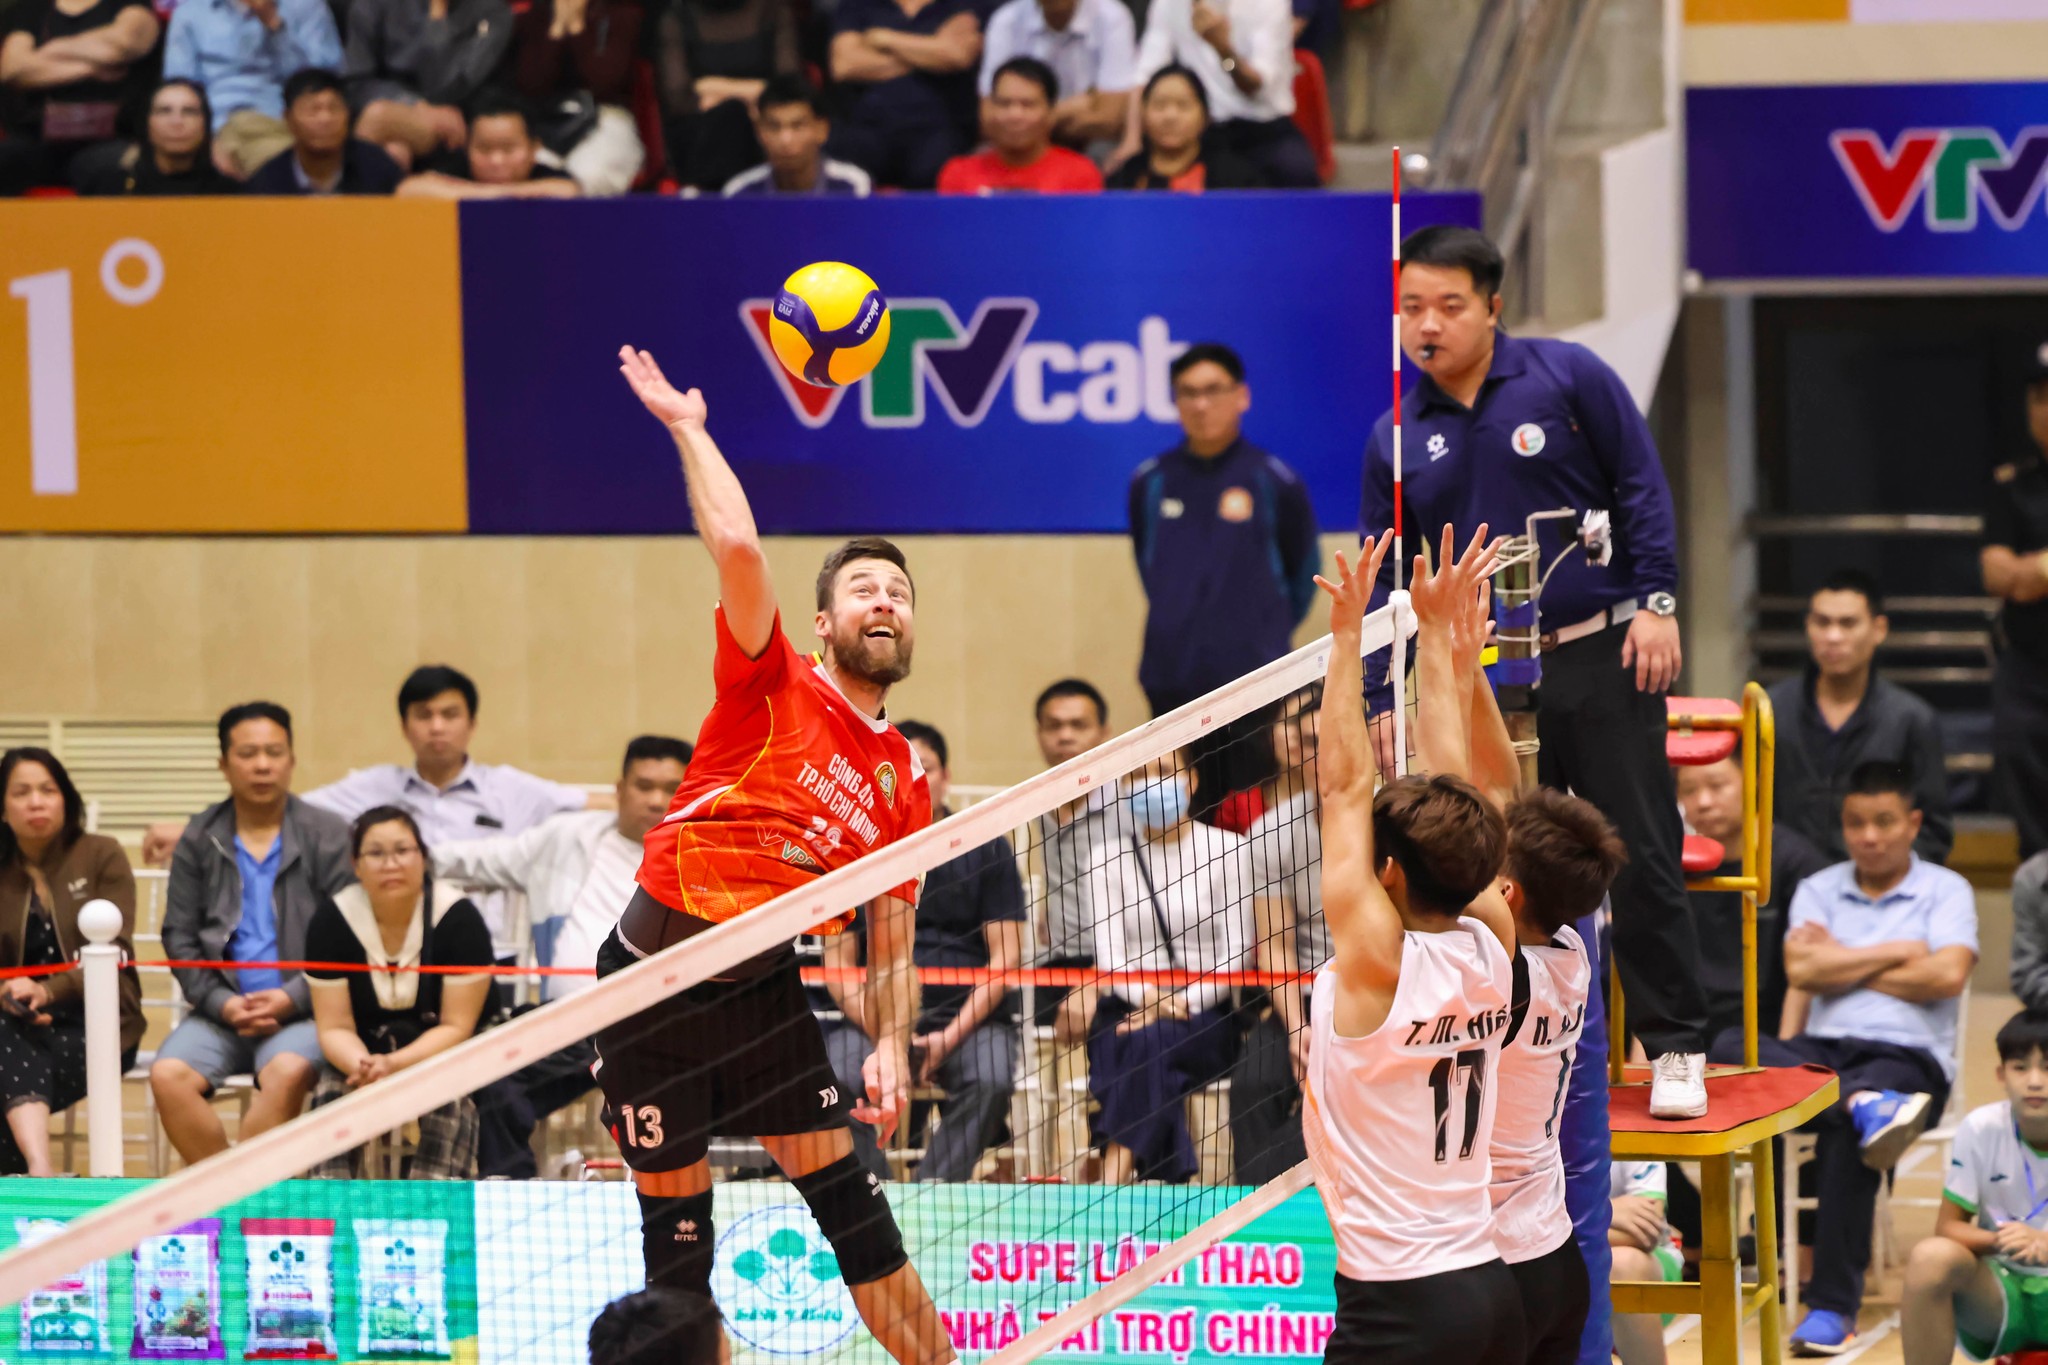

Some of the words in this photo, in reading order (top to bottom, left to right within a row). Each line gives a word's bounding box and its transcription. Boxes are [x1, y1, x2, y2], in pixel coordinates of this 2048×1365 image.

[828, 753, 863, 794] CÔNG
[847, 807, 880, 847] MINH
[1404, 1020, 1427, 1046] T.
[1429, 1014, 1460, 1044] M.
[621, 1105, 664, 1148] 13
[1428, 1048, 1488, 1164] 17
[971, 1242, 1077, 1282] SUPE
[1201, 1244, 1301, 1284] THAO
[940, 1303, 1021, 1350] NHÀ
[1115, 1311, 1194, 1361] TRỢ
[1208, 1306, 1334, 1354] CHÍNH
